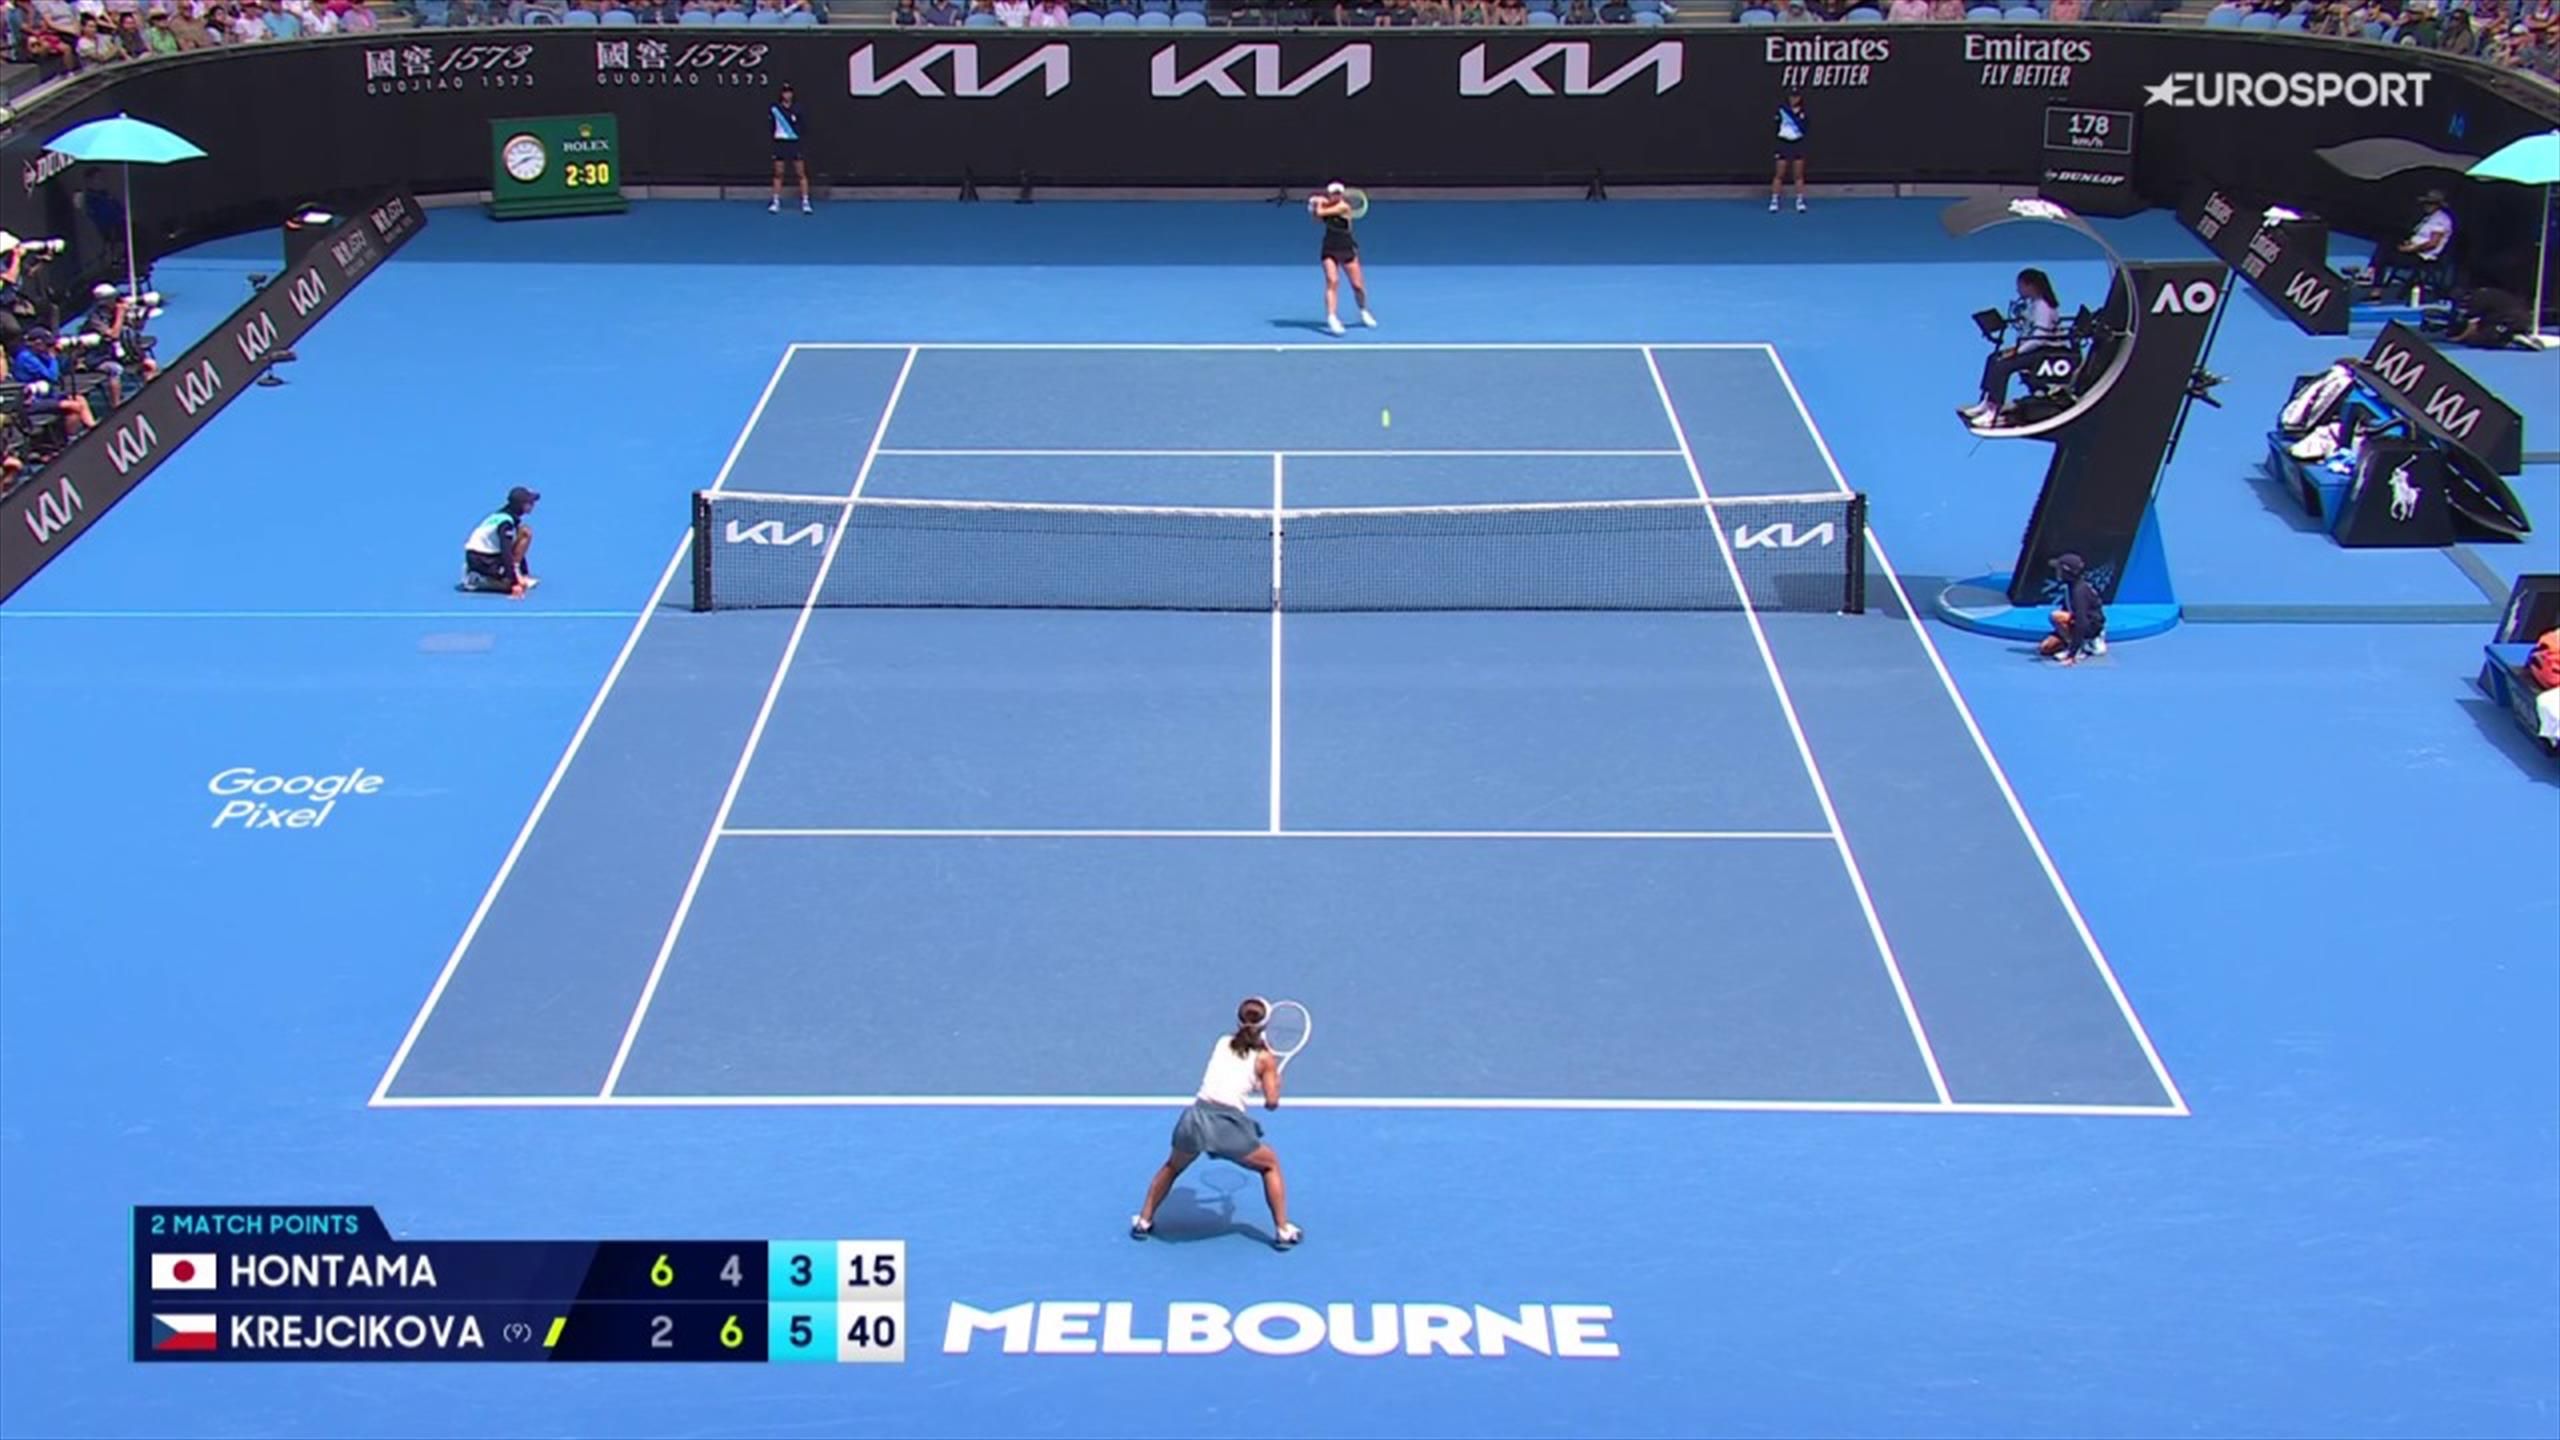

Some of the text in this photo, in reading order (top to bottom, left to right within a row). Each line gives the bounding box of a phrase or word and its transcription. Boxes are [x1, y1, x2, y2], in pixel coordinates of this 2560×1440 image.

[1765, 36, 1889, 62] Emirates
[1965, 34, 2091, 62] Emirates
[367, 74, 534, 95] GUOJIAO 1573
[597, 72, 768, 85] GUOJIAO 1573
[849, 43, 1070, 97] KIA
[1151, 43, 1372, 97] KIA
[1459, 41, 1683, 96] KIA
[1782, 64, 1870, 87] FLY BETTER
[1981, 65, 2071, 87] FLY BETTER
[2068, 114, 2109, 135] 178
[563, 141, 609, 152] ROLEX
[36, 151, 76, 184] DUN
[566, 163, 609, 186] 2:30
[2058, 171, 2125, 185] DUNLOP
[289, 266, 327, 316] KIA
[2151, 281, 2217, 314] AO
[2285, 271, 2330, 316] KIA
[237, 311, 277, 363] KIA
[2036, 359, 2071, 377] AO
[2374, 342, 2425, 393] KIA
[175, 359, 222, 416] KIA
[2424, 384, 2481, 439] KIA
[106, 414, 158, 475] KIA
[25, 477, 84, 543] KIA
[725, 519, 824, 547] KIA
[1735, 522, 1834, 548] KIA
[207, 767, 385, 802] Google
[210, 799, 337, 829] Pixel
[942, 1300, 1621, 1358] MELBOURNE
